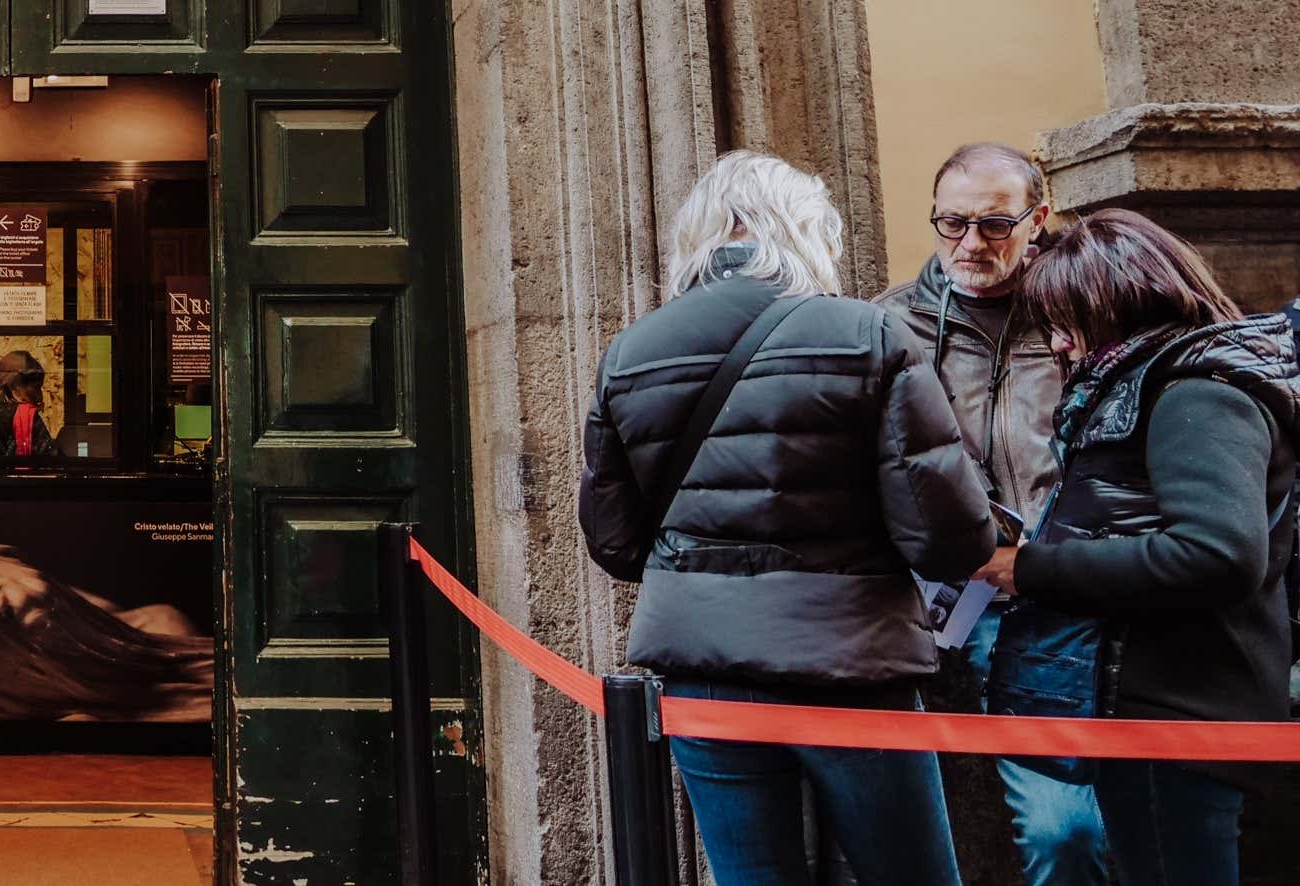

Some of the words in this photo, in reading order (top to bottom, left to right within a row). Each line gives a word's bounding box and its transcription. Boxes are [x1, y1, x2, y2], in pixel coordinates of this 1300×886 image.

[134, 522, 156, 530] Cristo
[158, 522, 198, 532] velato/The
[152, 533, 186, 541] Giuseppe
